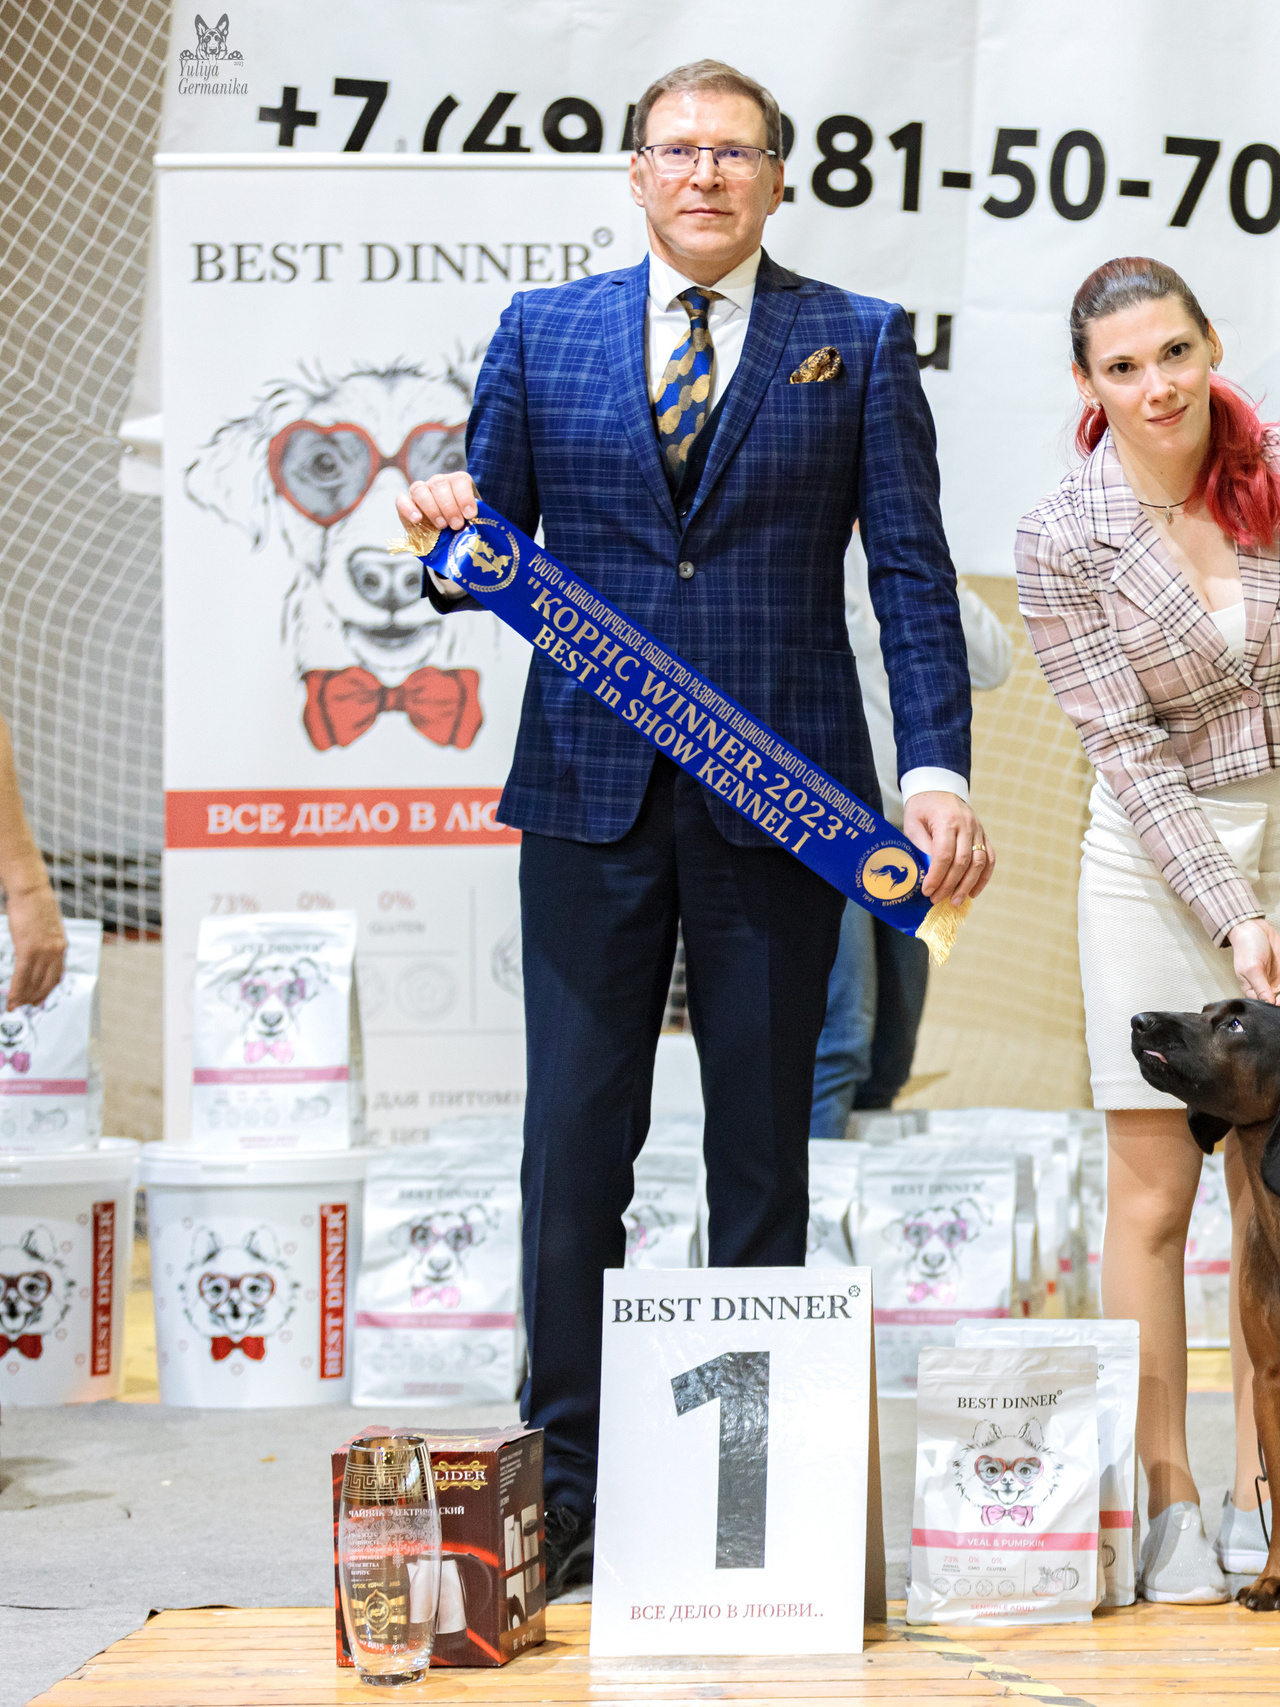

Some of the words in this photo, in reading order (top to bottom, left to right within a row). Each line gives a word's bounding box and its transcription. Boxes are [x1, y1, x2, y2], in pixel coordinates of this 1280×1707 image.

[258, 77, 390, 152] +7
[190, 243, 342, 283] BEST
[361, 242, 594, 283] DINNER
[528, 553, 564, 586] РООТО
[563, 580, 647, 652] КИНОЛОГИЧЕСКОЕ
[640, 641, 692, 687] ОБЩЕСТВО
[685, 676, 736, 723] РАЗВИТИЯ
[728, 710, 808, 779] НАЦИОНАЛЬНОГО
[533, 624, 600, 683] BEST
[593, 675, 622, 709] in
[621, 698, 704, 765] SHOW
[696, 756, 794, 843] KENNEL
[207, 803, 285, 834] ВСЕ
[290, 801, 400, 837] ДЕЛО
[410, 801, 436, 832] В
[297, 891, 336, 911] 0%
[377, 890, 416, 912] 0%
[612, 1298, 701, 1323] BEST
[711, 1295, 853, 1322] DINNER
[957, 1397, 998, 1409] BEST
[1002, 1394, 1058, 1409] DINNER
[671, 1350, 770, 1569] 1
[348, 1507, 385, 1518] ЧАЙНИК
[967, 1538, 991, 1547] VEAL
[993, 1539, 1000, 1547] &
[1001, 1539, 1045, 1548] PUMPKIN
[968, 1556, 980, 1564] 0%
[630, 1605, 666, 1621] ВСЕ
[670, 1604, 722, 1623] ДЕЛО
[728, 1604, 738, 1618] В
